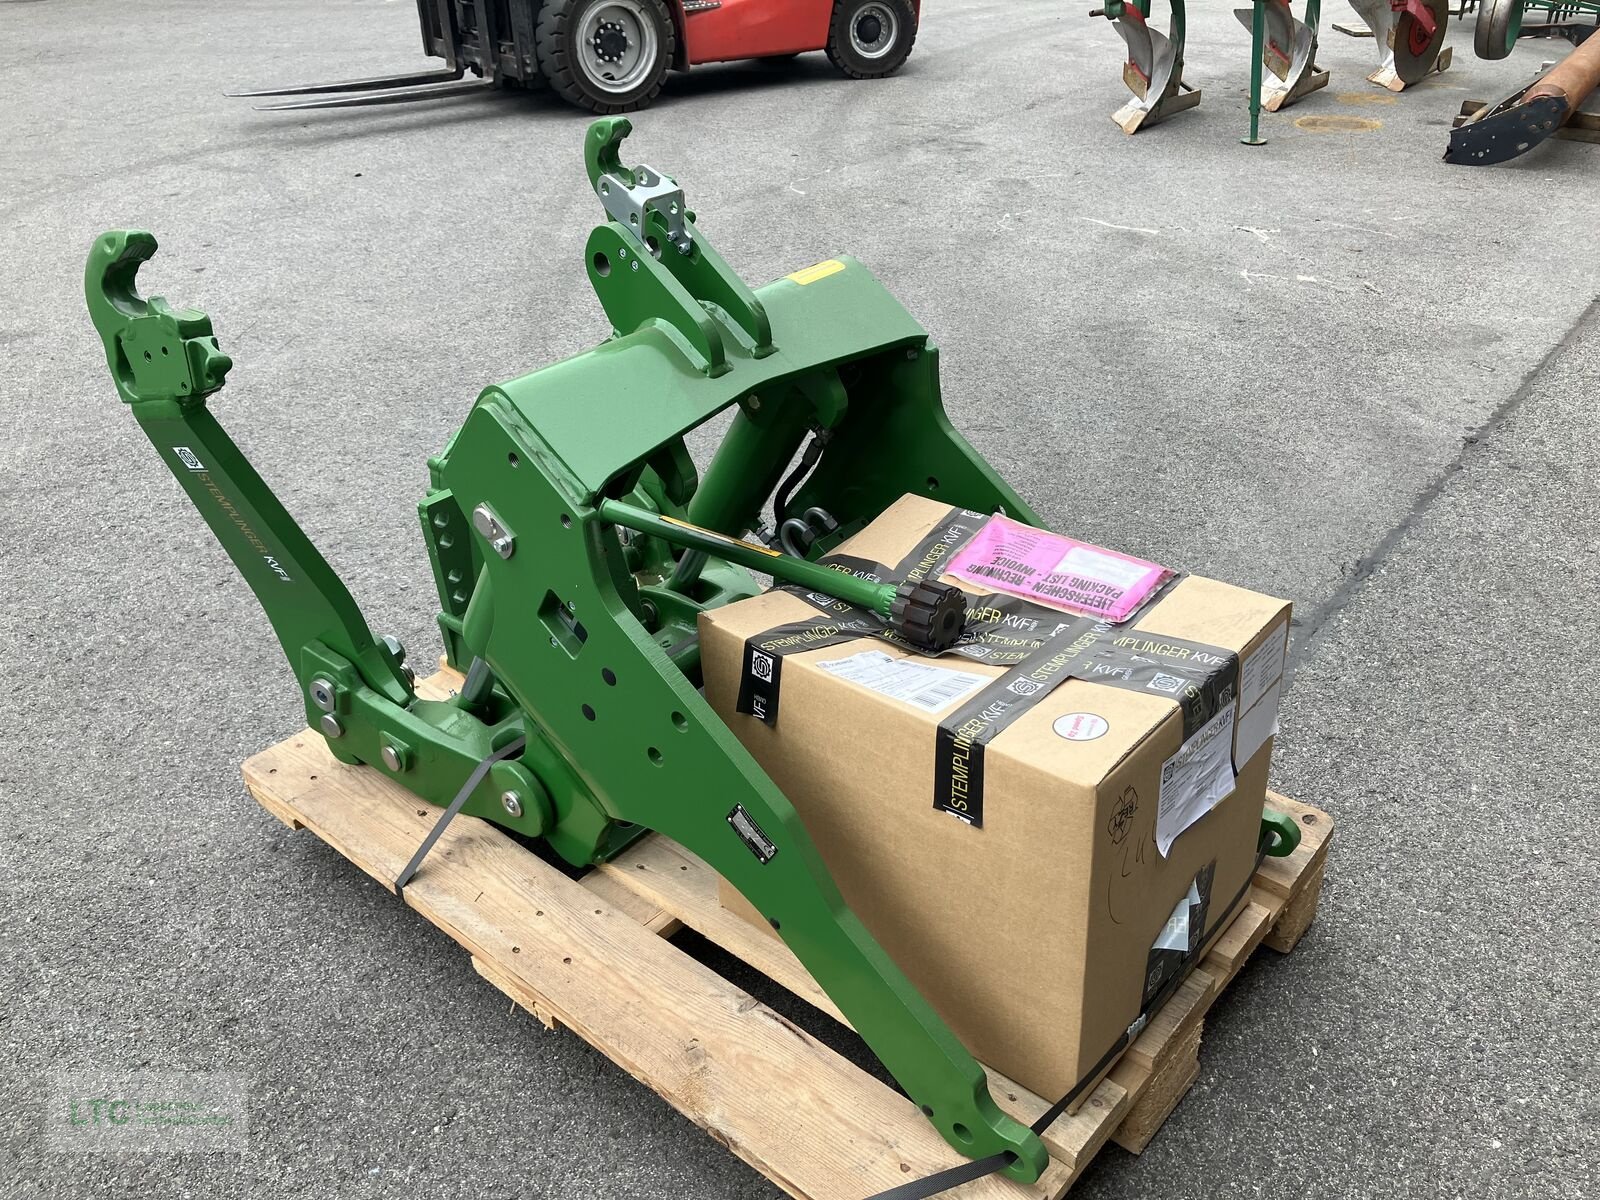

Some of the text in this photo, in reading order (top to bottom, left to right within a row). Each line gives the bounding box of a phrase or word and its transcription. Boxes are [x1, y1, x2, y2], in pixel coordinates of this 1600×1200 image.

[199, 473, 288, 577] STEMPLINGER KVF
[941, 526, 962, 544] KVF
[965, 564, 1026, 587] RECHNUNG
[990, 556, 1038, 577] INVOICE
[1046, 571, 1071, 586] LIST
[1068, 576, 1124, 600] PACKING
[1032, 581, 1115, 611] LIEFERSCHEIN
[1002, 613, 1032, 630] KVF
[1032, 631, 1102, 681] STEMPLINGER
[1190, 650, 1226, 665] KVF
[1092, 663, 1128, 676] KVF
[951, 718, 988, 812] STEMPLINGER
[980, 700, 1008, 723] KVF
